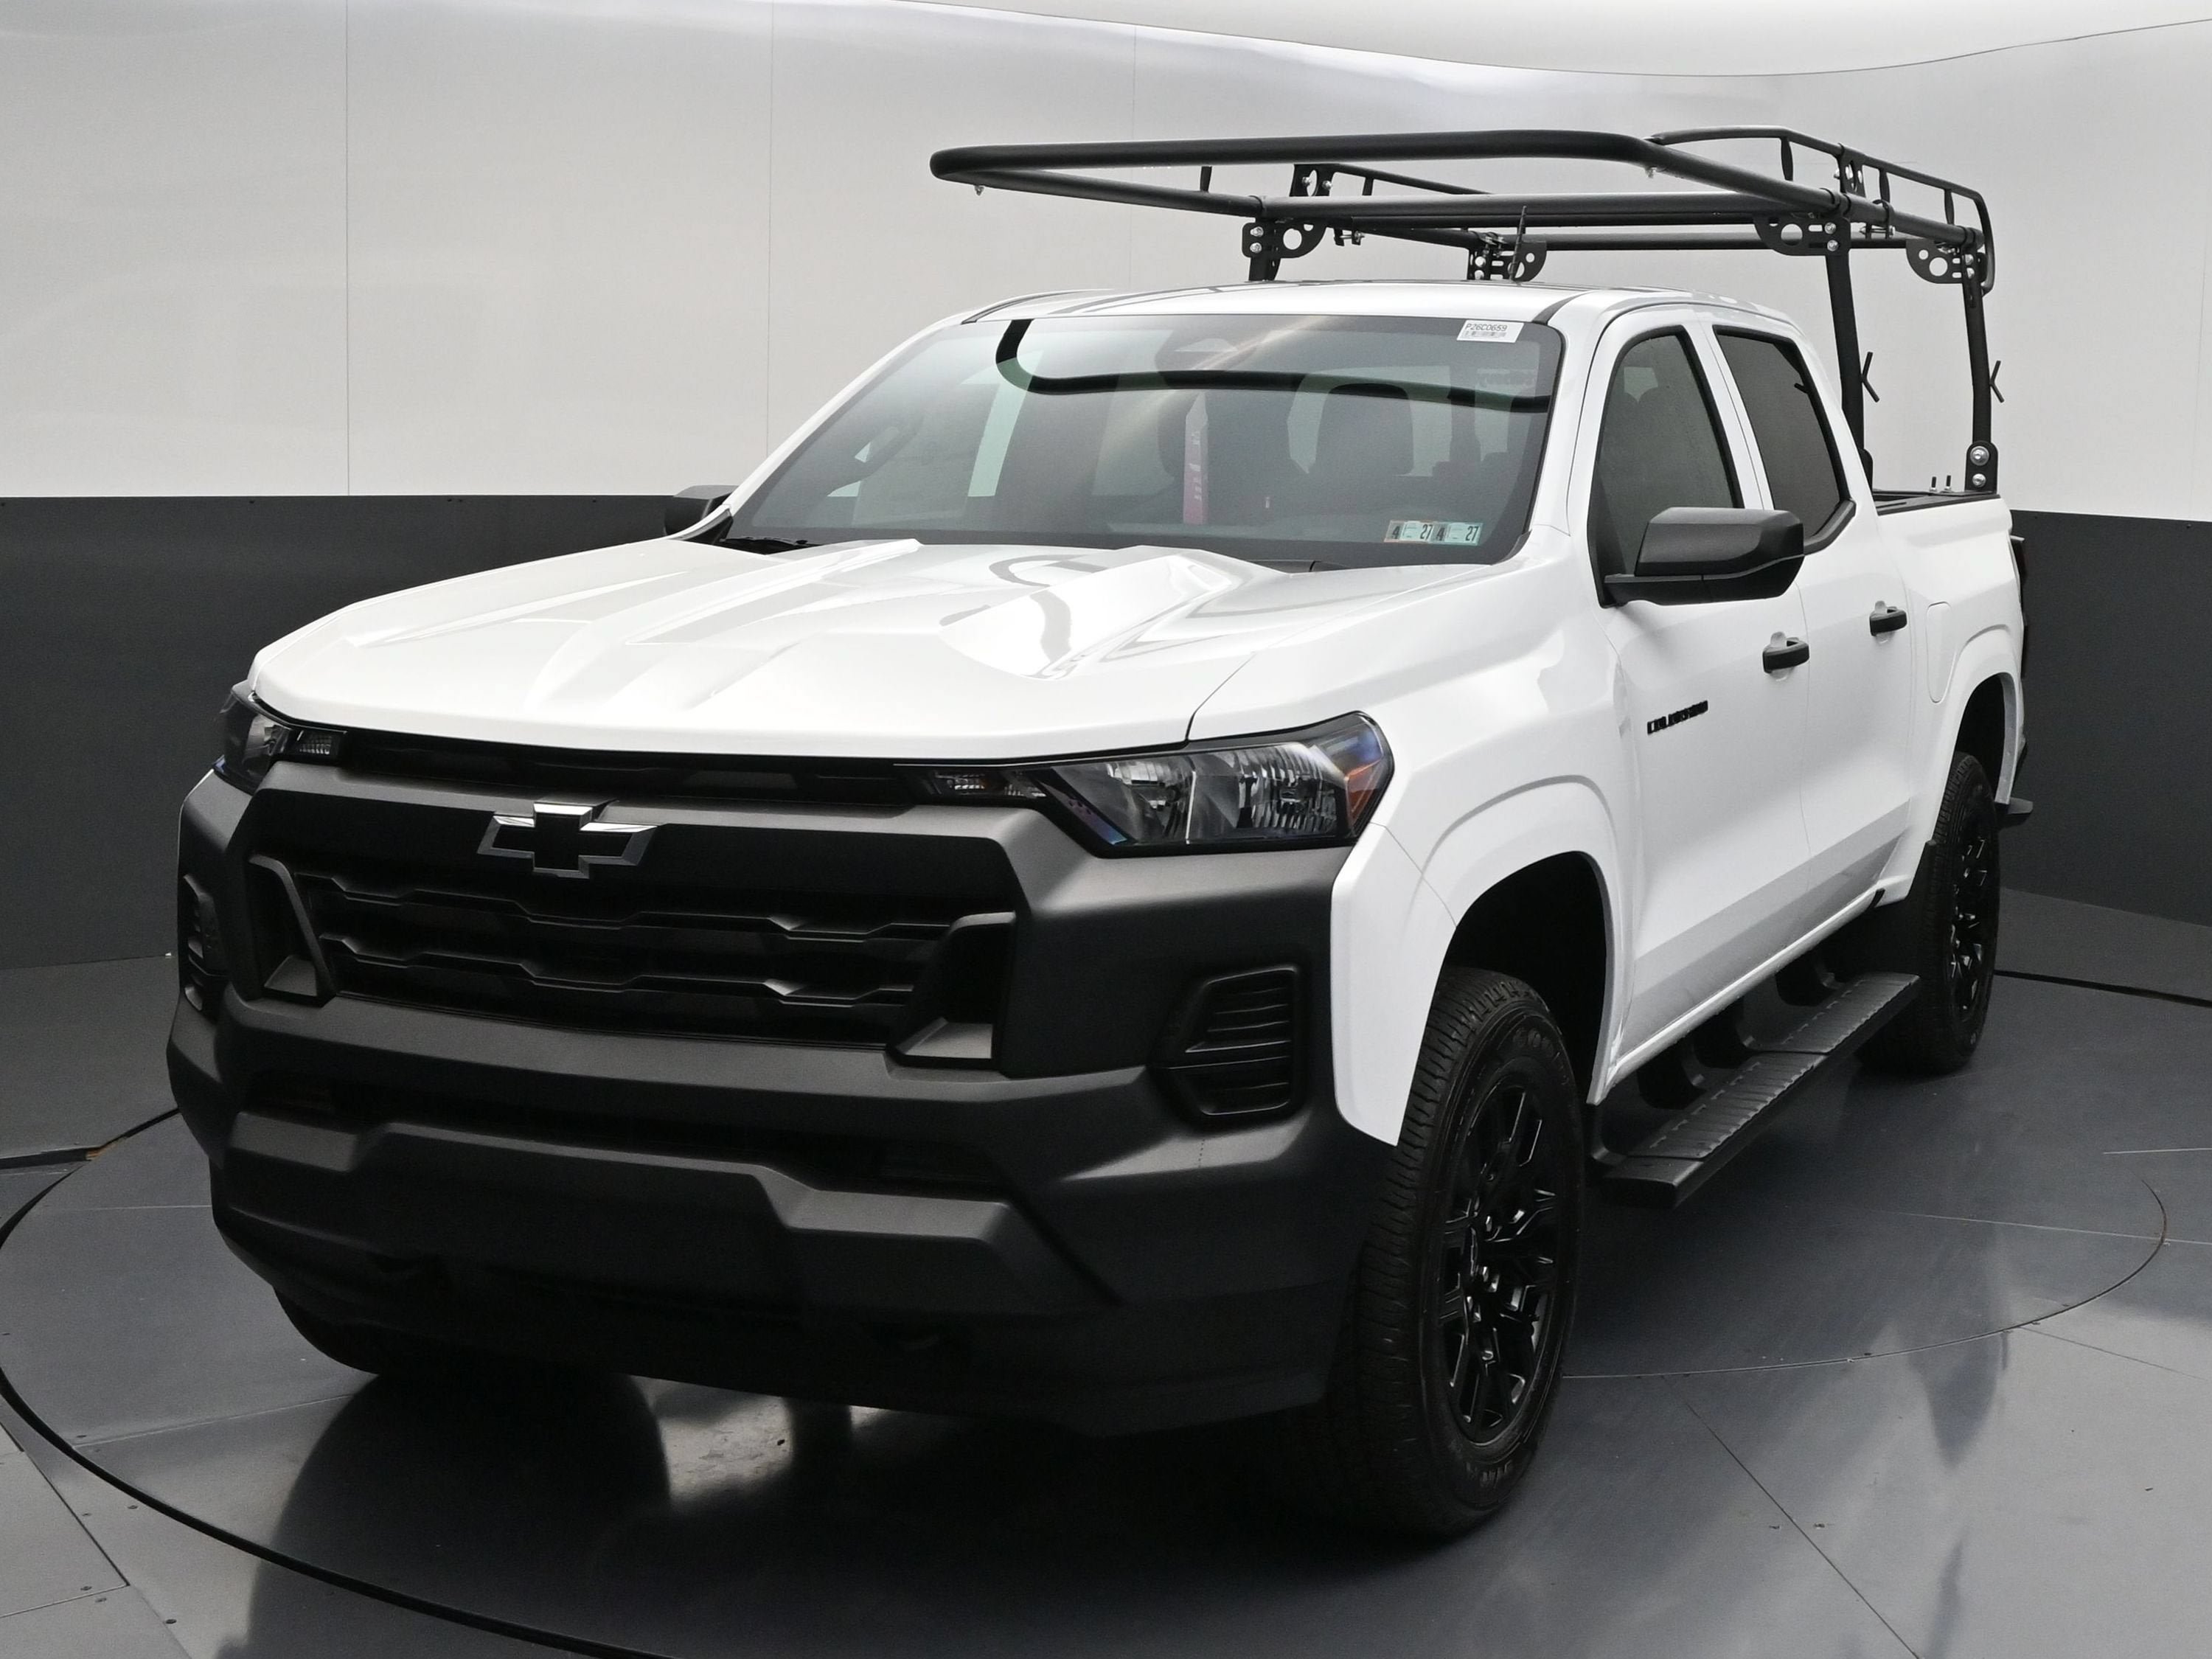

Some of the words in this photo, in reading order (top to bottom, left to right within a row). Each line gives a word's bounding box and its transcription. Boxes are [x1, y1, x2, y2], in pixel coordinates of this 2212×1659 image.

[1392, 526, 1400, 539] 4
[1420, 524, 1433, 540] 27
[1436, 527, 1445, 541] 4
[1465, 526, 1479, 541] 27
[1647, 700, 1709, 735] COLOR
